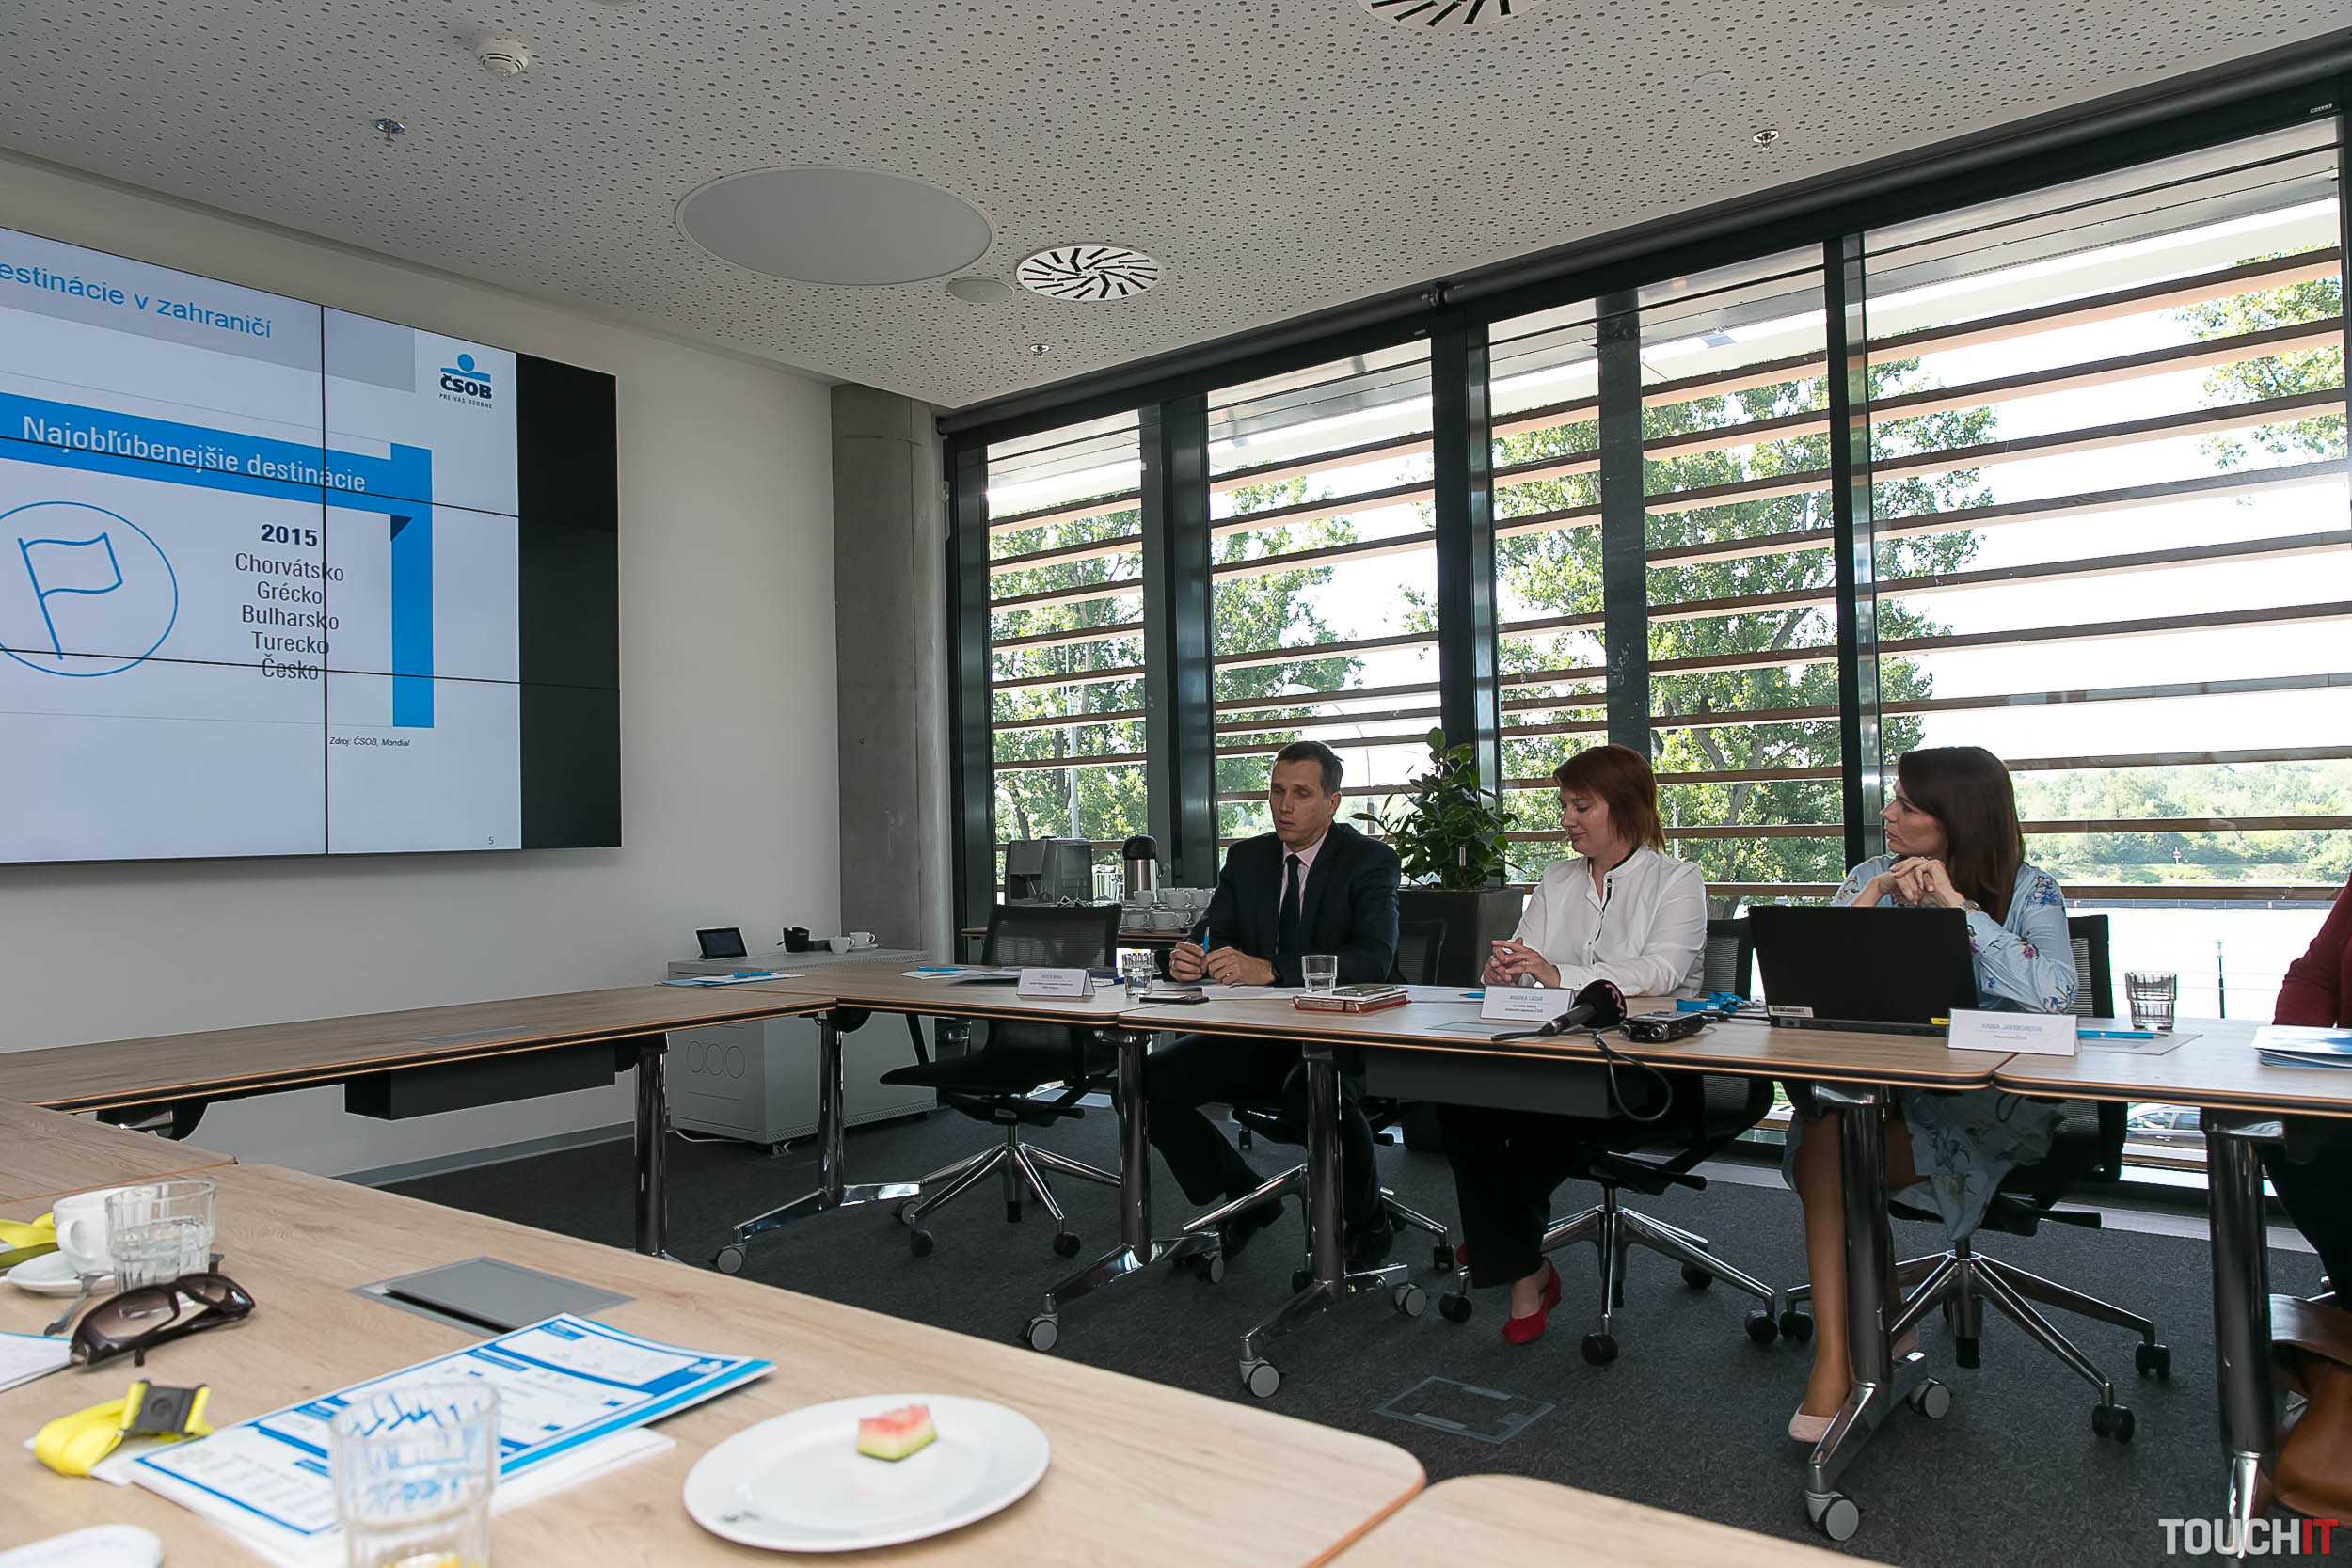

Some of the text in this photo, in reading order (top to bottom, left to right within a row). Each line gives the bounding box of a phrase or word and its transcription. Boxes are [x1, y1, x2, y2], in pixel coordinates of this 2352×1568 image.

[134, 293, 149, 309] v
[157, 298, 272, 338] zahraničí
[440, 373, 492, 399] ČSOB
[23, 416, 366, 492] Najobľúbenejšie destinácie
[261, 524, 318, 546] 2015
[235, 553, 344, 581] Chorvátsko
[257, 580, 323, 604] Grécko
[242, 605, 339, 630] Bulharsko
[251, 631, 329, 654] Turecko
[262, 653, 319, 680] Česko
[381, 738, 410, 747] Mondial
